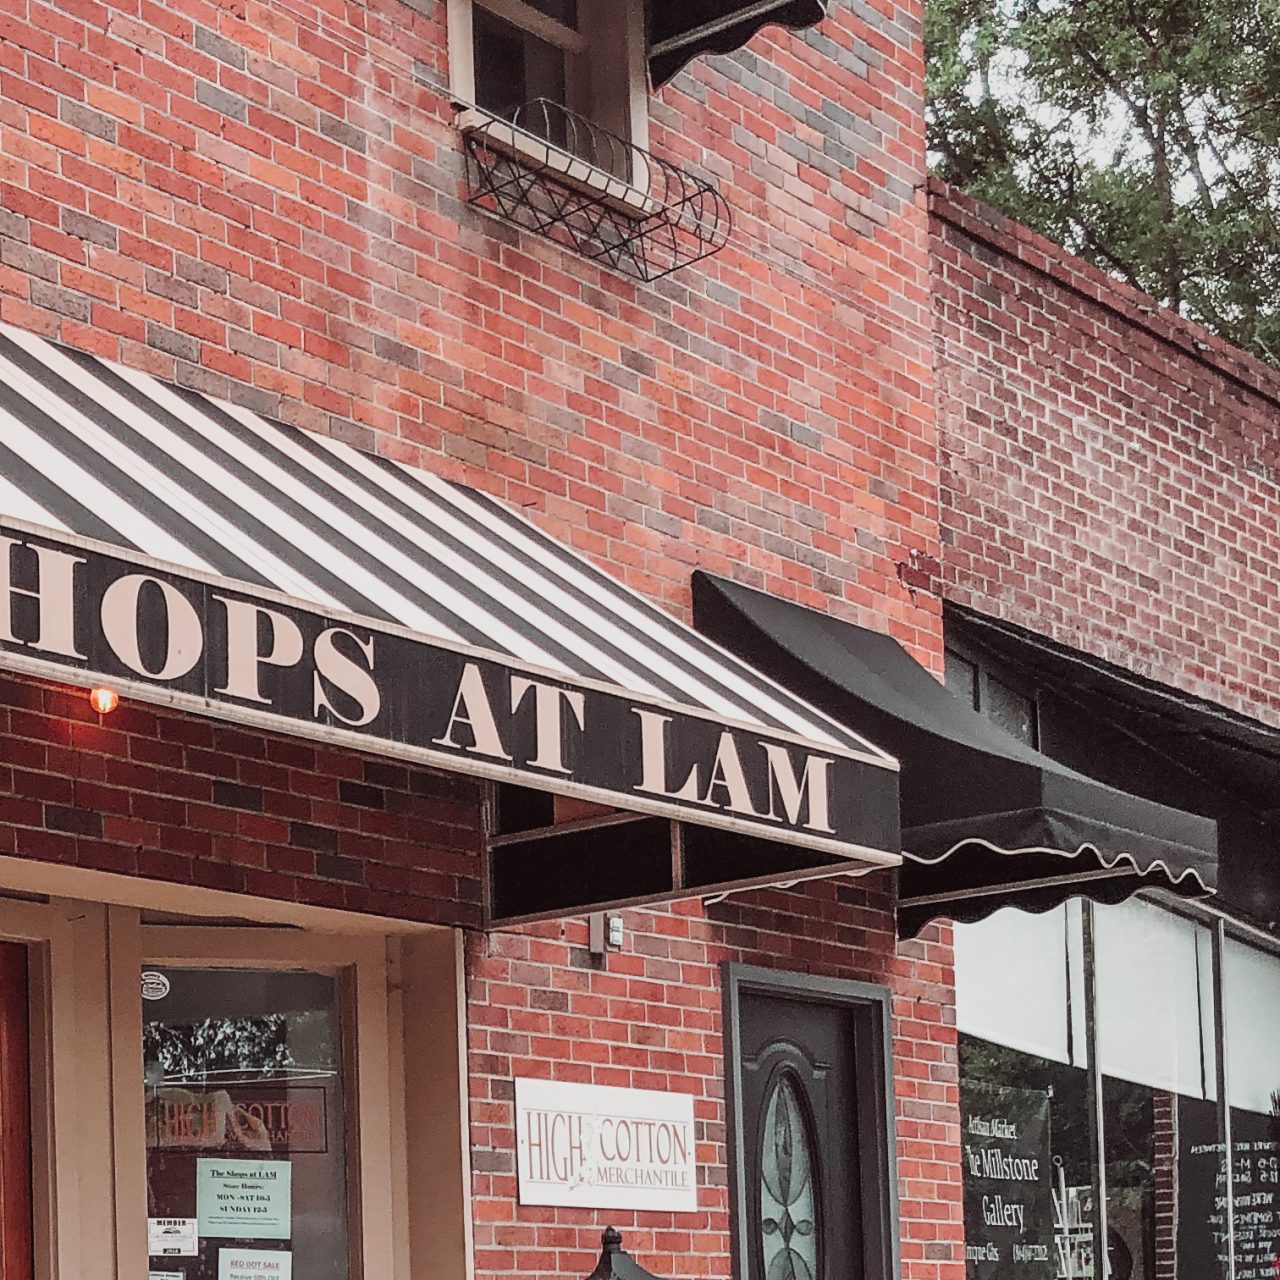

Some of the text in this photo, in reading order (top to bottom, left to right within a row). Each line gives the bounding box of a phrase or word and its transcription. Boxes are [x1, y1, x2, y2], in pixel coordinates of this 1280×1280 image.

[431, 664, 586, 774] AT
[631, 707, 837, 834] LAM
[526, 1111, 688, 1183] HIGH COTTON
[210, 1169, 224, 1177] The
[226, 1170, 248, 1178] Shops
[258, 1171, 277, 1179] LAM
[596, 1165, 690, 1188] MERCHANTILE
[982, 1148, 1039, 1181] Millstone
[219, 1205, 251, 1213] SUNDAY
[982, 1195, 1024, 1234] Gallery
[230, 1260, 245, 1268] RED
[246, 1261, 261, 1269] DOT
